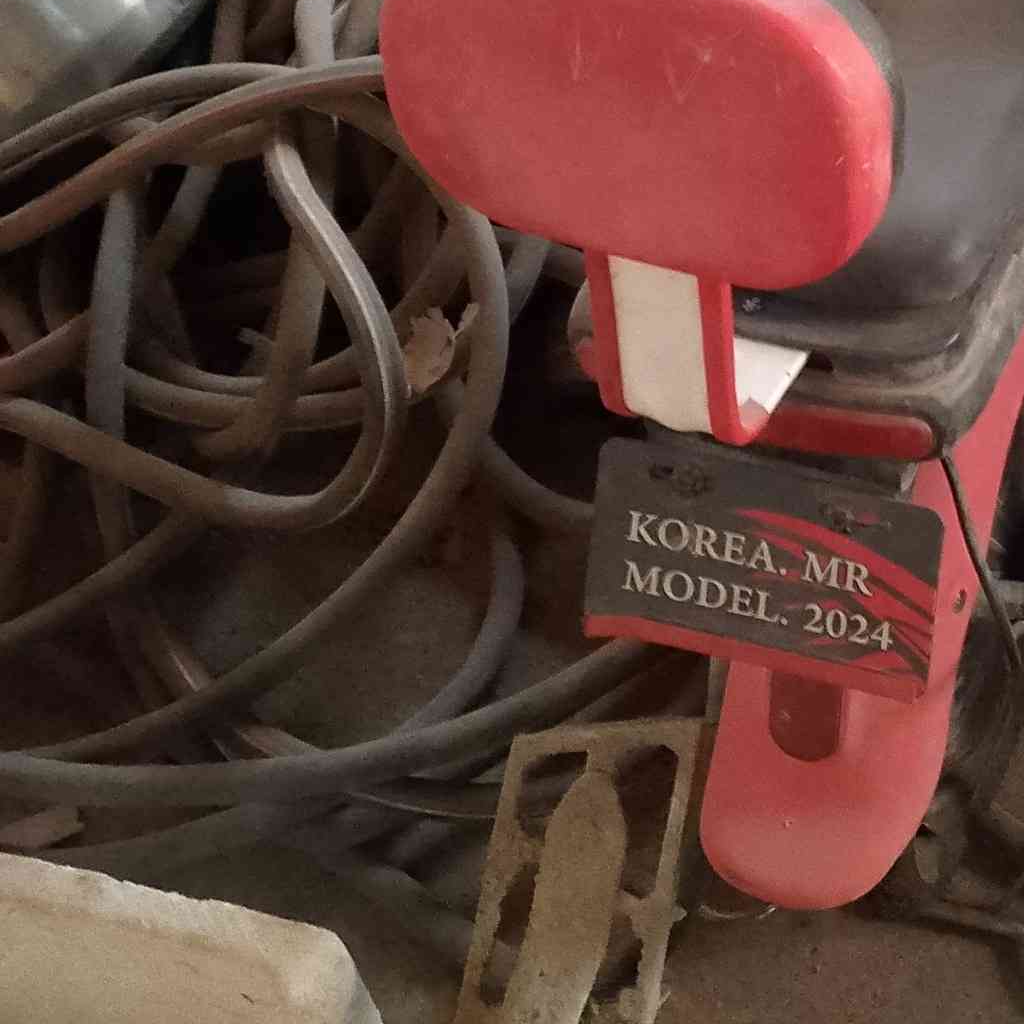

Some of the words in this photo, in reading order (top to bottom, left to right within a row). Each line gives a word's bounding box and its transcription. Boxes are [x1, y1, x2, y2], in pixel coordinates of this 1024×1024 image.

[625, 509, 788, 576] KOREA.
[800, 551, 873, 598] MR
[621, 559, 788, 626] MODEL.
[803, 602, 894, 651] 2024
